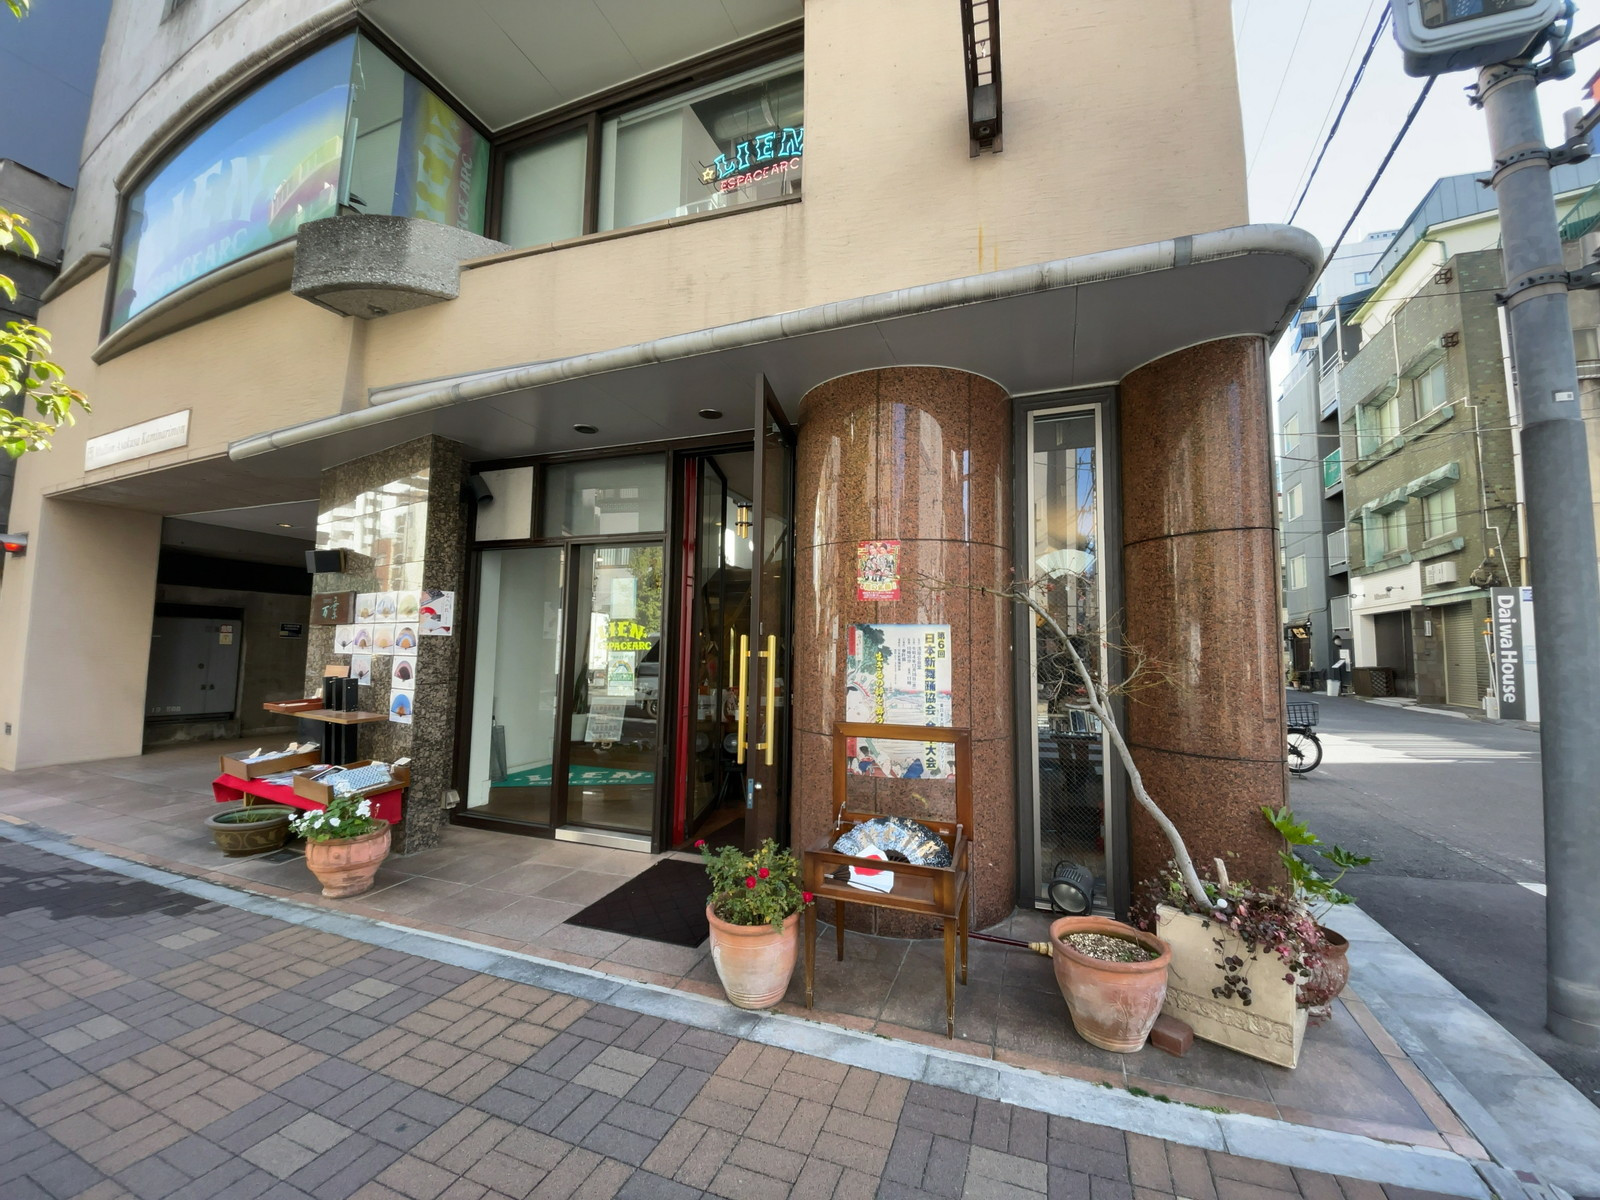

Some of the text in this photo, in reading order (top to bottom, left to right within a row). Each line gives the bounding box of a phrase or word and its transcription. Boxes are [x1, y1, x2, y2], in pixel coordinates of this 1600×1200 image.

[714, 128, 805, 178] LIEN
[937, 632, 946, 658] 第6回
[924, 633, 936, 715] 日本新舞踊協会
